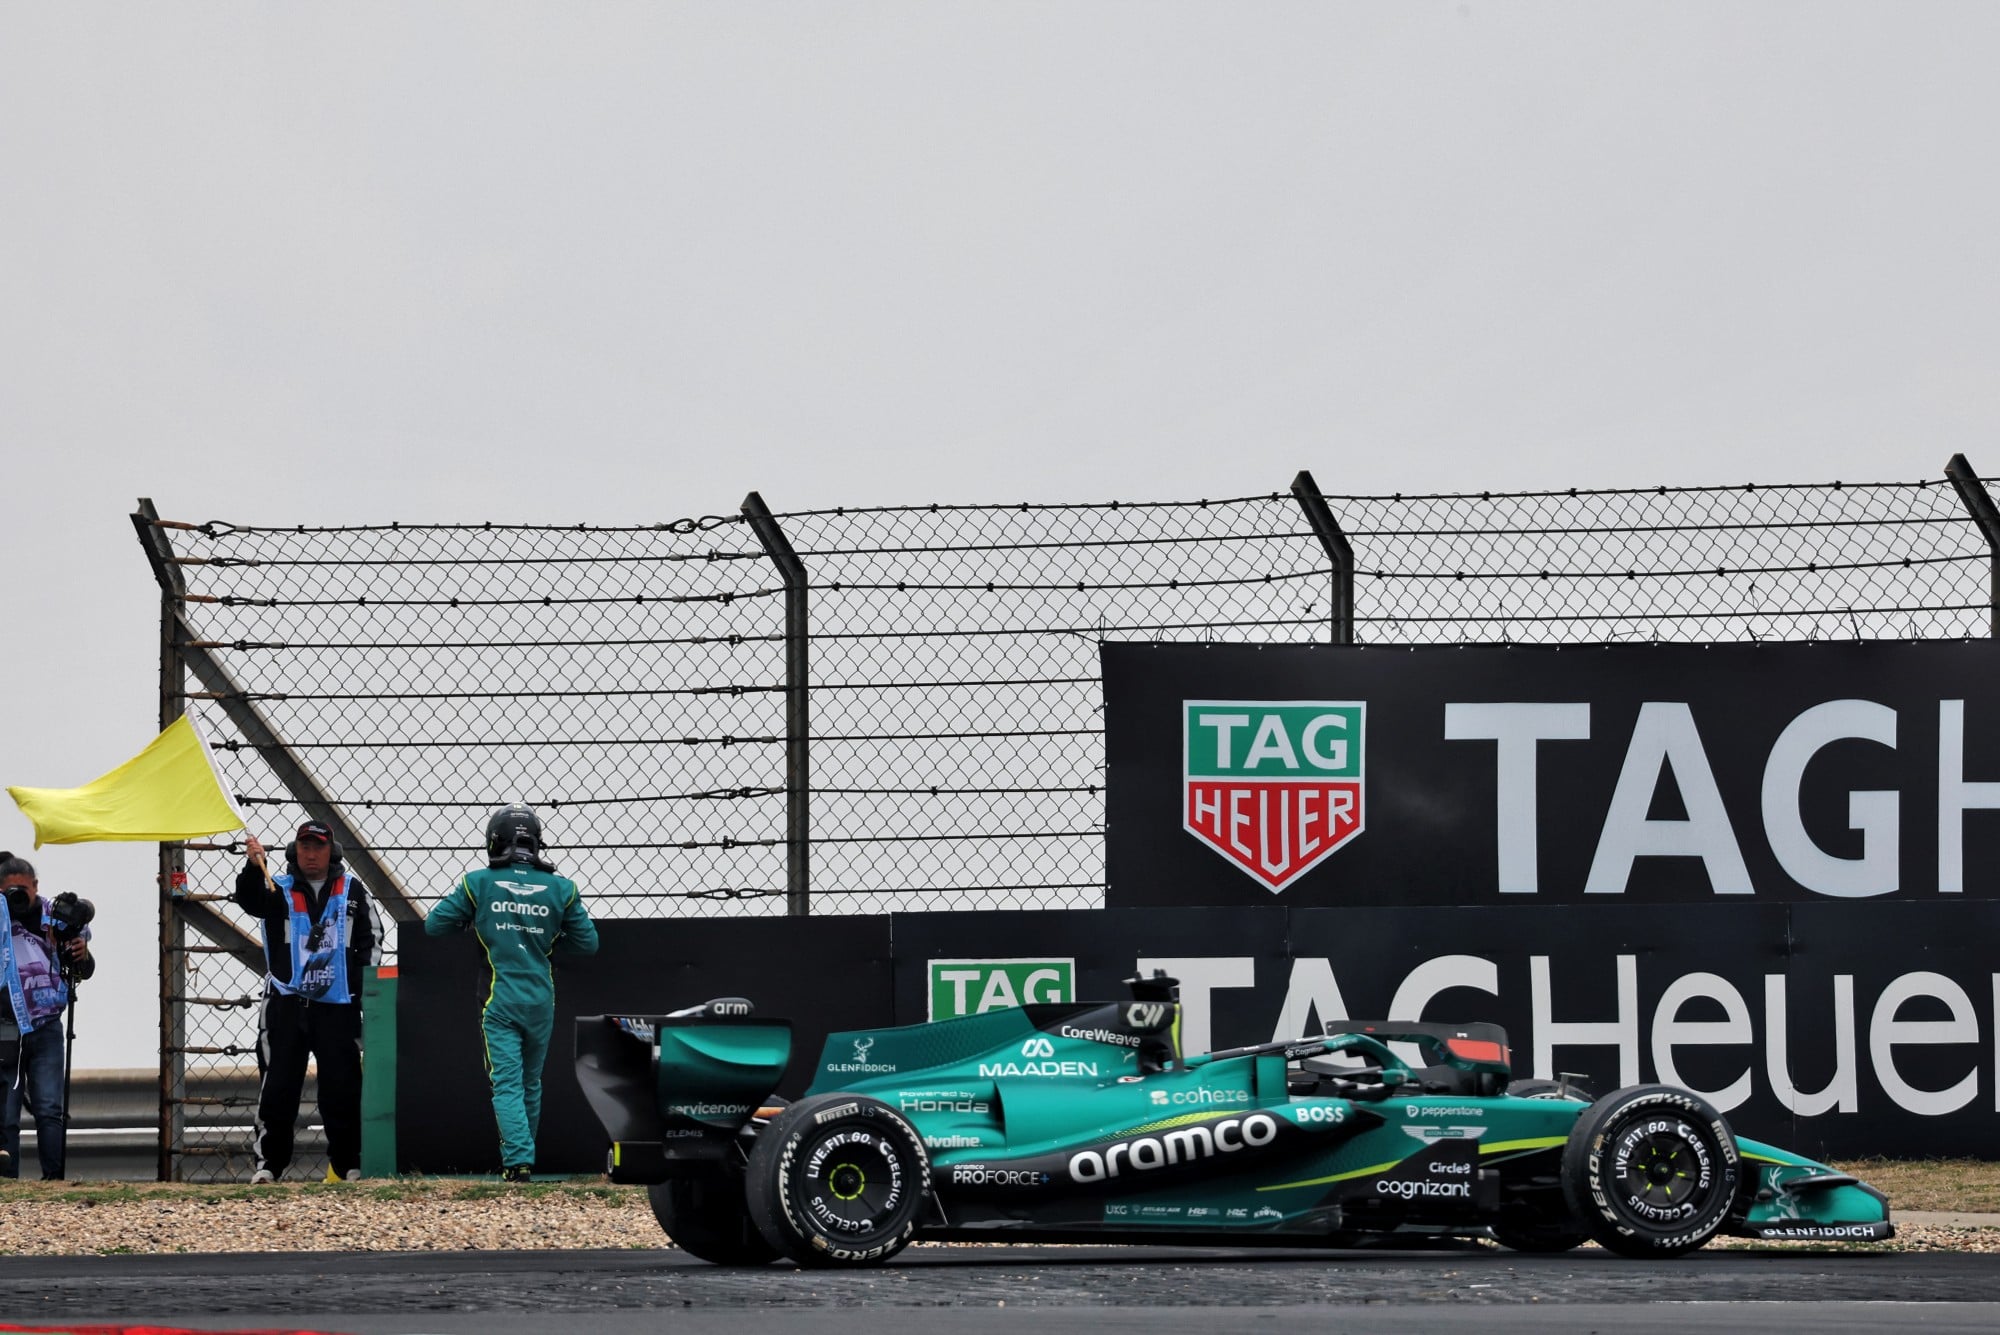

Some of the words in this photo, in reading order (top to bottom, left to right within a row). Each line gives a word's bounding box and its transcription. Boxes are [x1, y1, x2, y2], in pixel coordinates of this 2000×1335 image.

[1199, 714, 1350, 771] TAG
[1194, 787, 1355, 878] HEUER
[491, 901, 549, 917] aramco
[507, 922, 544, 934] Honda
[940, 969, 1061, 1015] TAG
[713, 1002, 748, 1015] arm
[1061, 1025, 1141, 1048] CoreWeave
[827, 1063, 896, 1072] GLENFIDDICH
[978, 1061, 1098, 1077] MAADEN
[900, 1098, 989, 1113] Honda
[1172, 1087, 1249, 1104] cohere
[667, 1102, 750, 1115] servicenow
[814, 1102, 860, 1125] PIRELLI
[1296, 1106, 1344, 1123] BOSS
[1421, 1106, 1484, 1118] pepperstone
[666, 1130, 703, 1138] ELEMIS
[1711, 1119, 1738, 1165] PIRELLI
[1068, 1114, 1277, 1183] aramco
[1688, 1134, 1712, 1189] CELSIUS
[885, 1153, 902, 1210] CELSIUS
[1377, 1179, 1470, 1200] cognizant
[1589, 1154, 1619, 1223] ZERO
[811, 1196, 859, 1231] CELSIUS
[1627, 1195, 1681, 1220] CELSIUS
[1763, 1226, 1875, 1237] GLENFIDDICH
[831, 1236, 898, 1261] ZERO
